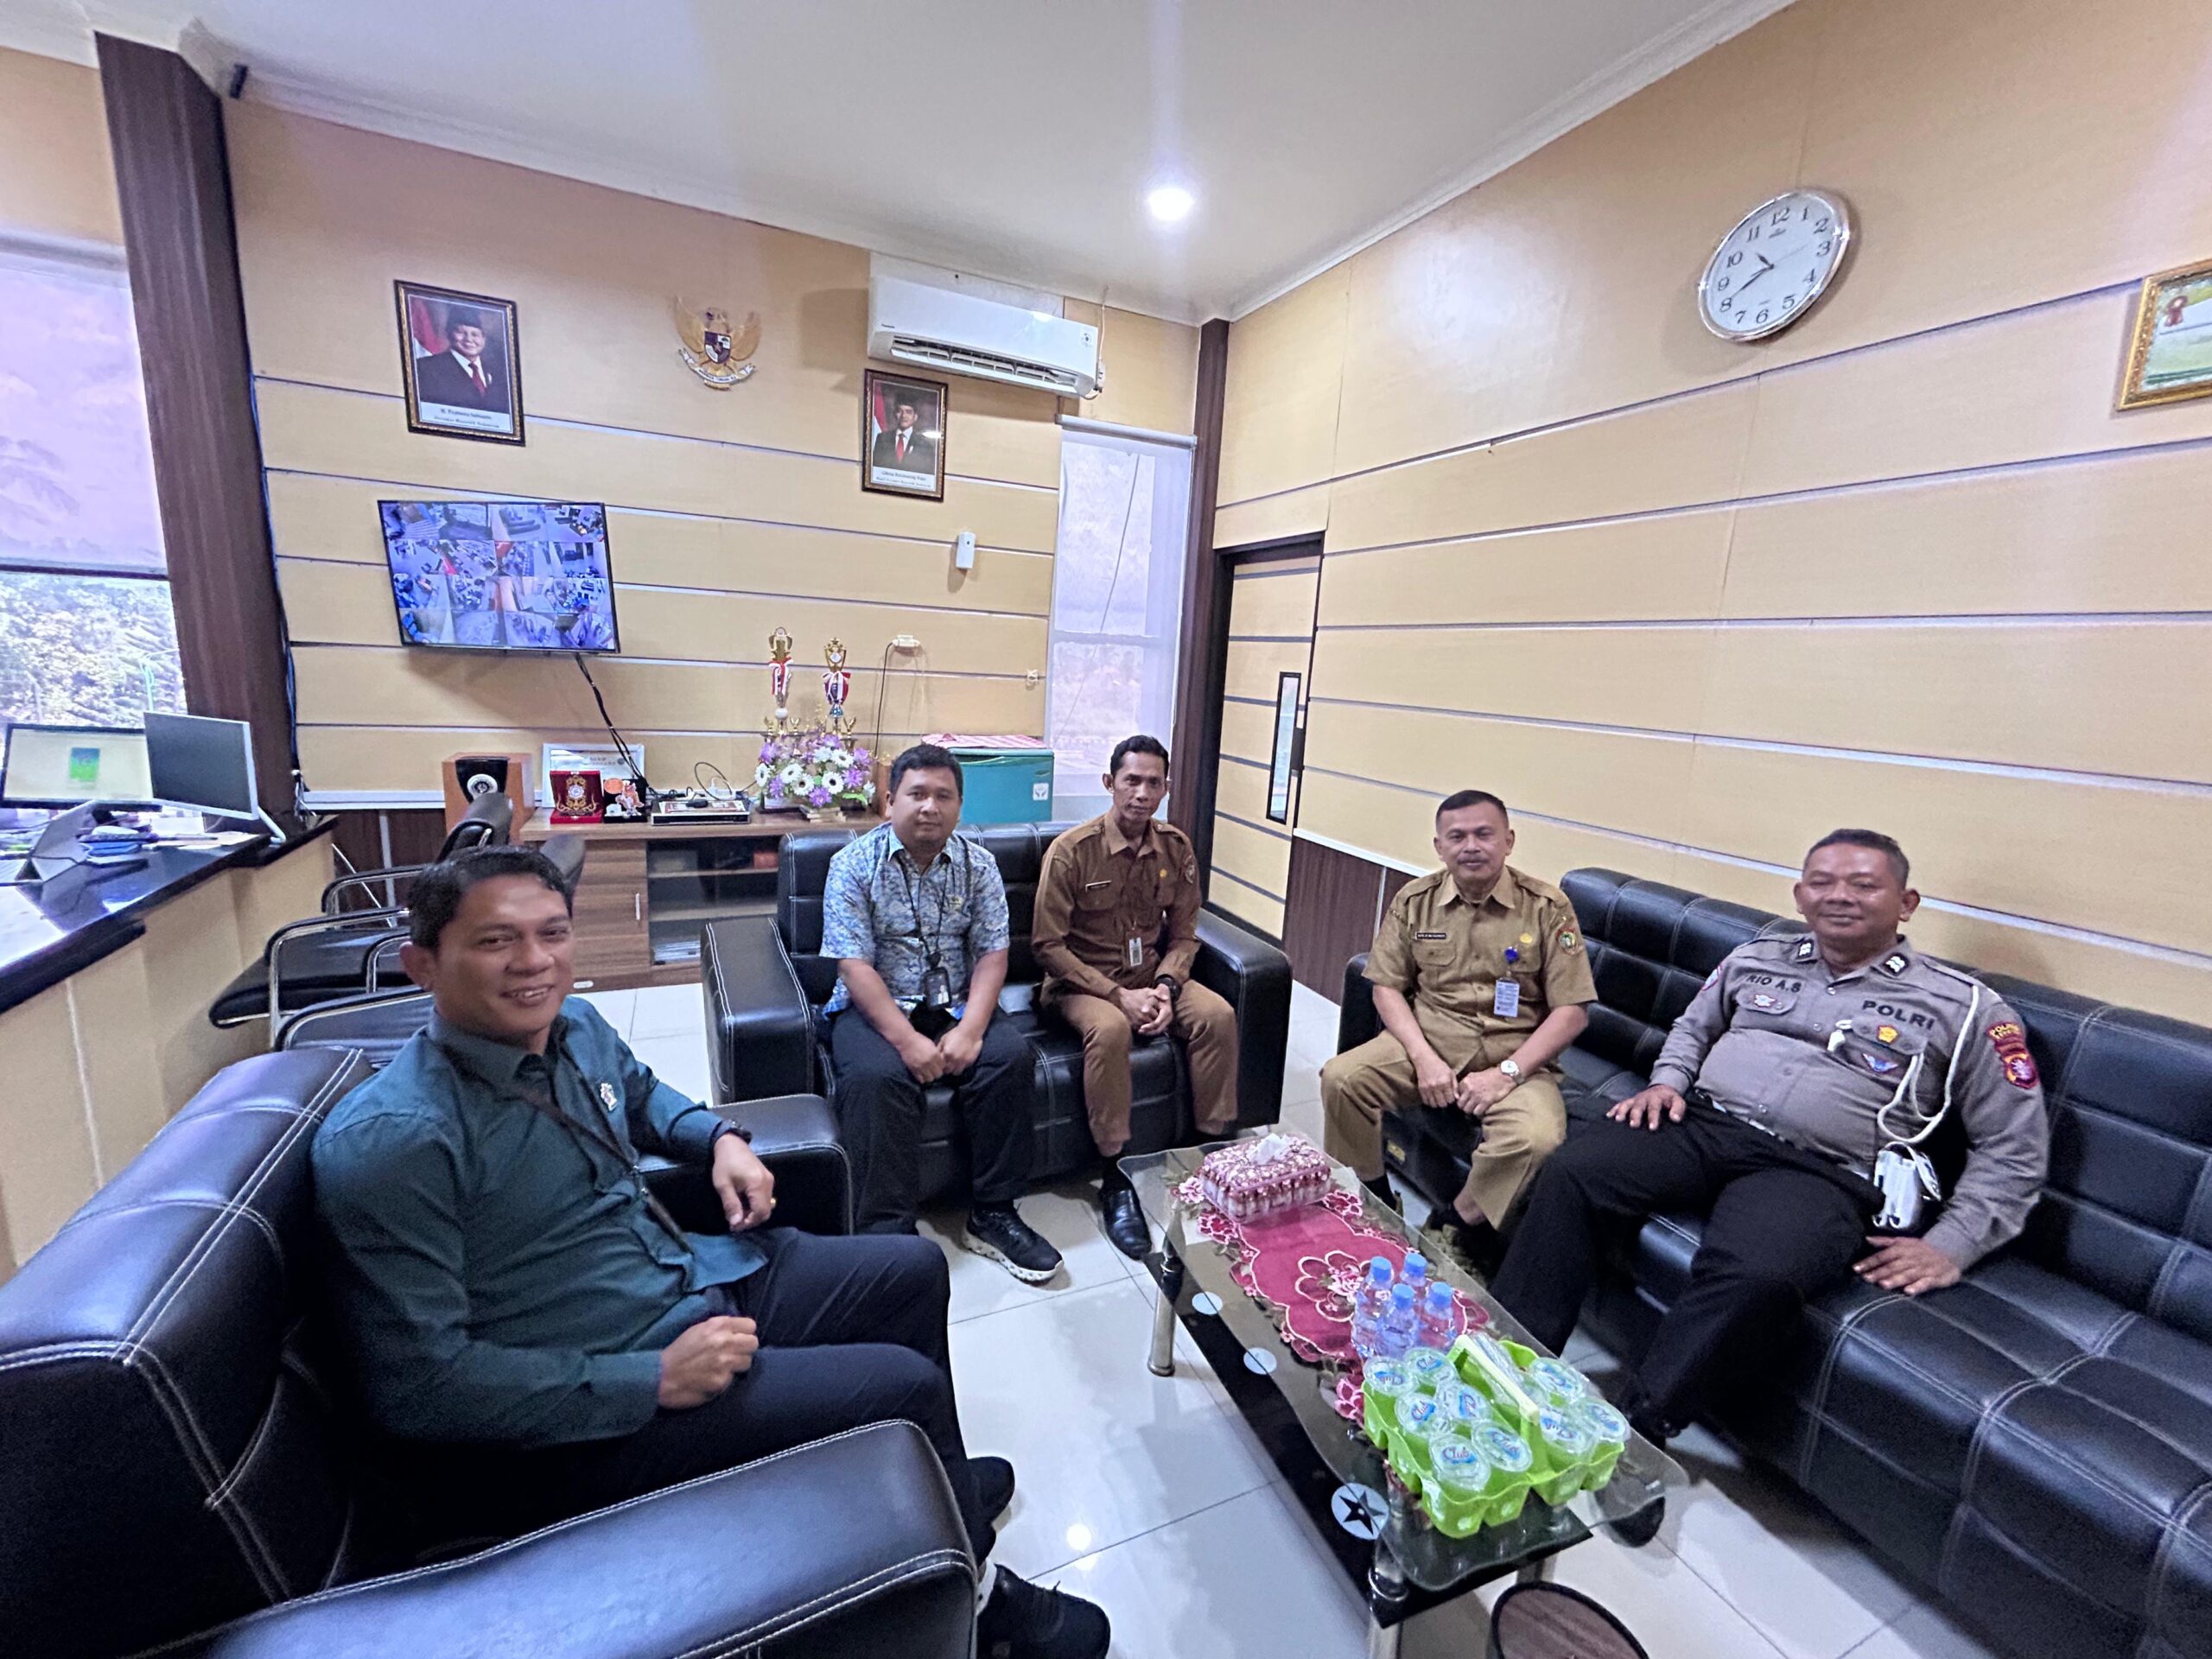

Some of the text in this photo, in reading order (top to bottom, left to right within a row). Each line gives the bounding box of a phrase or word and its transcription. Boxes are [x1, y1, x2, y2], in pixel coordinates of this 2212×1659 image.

[1771, 207, 1790, 226] 12
[1802, 207, 1809, 221] 1
[1814, 218, 1828, 234] 2
[1747, 226, 1760, 242] 11
[1816, 241, 1830, 257] 3
[1727, 251, 1743, 268] 10
[1718, 276, 1730, 290] 9
[1803, 269, 1816, 283] 4
[1719, 298, 1732, 312] 8
[1783, 294, 1796, 309] 5
[1736, 310, 1746, 324] 7
[1756, 309, 1769, 324] 6
[1746, 975, 1772, 985] RIO
[1862, 1000, 1935, 1031] POLRI
[1442, 1446, 1470, 1460] Club
